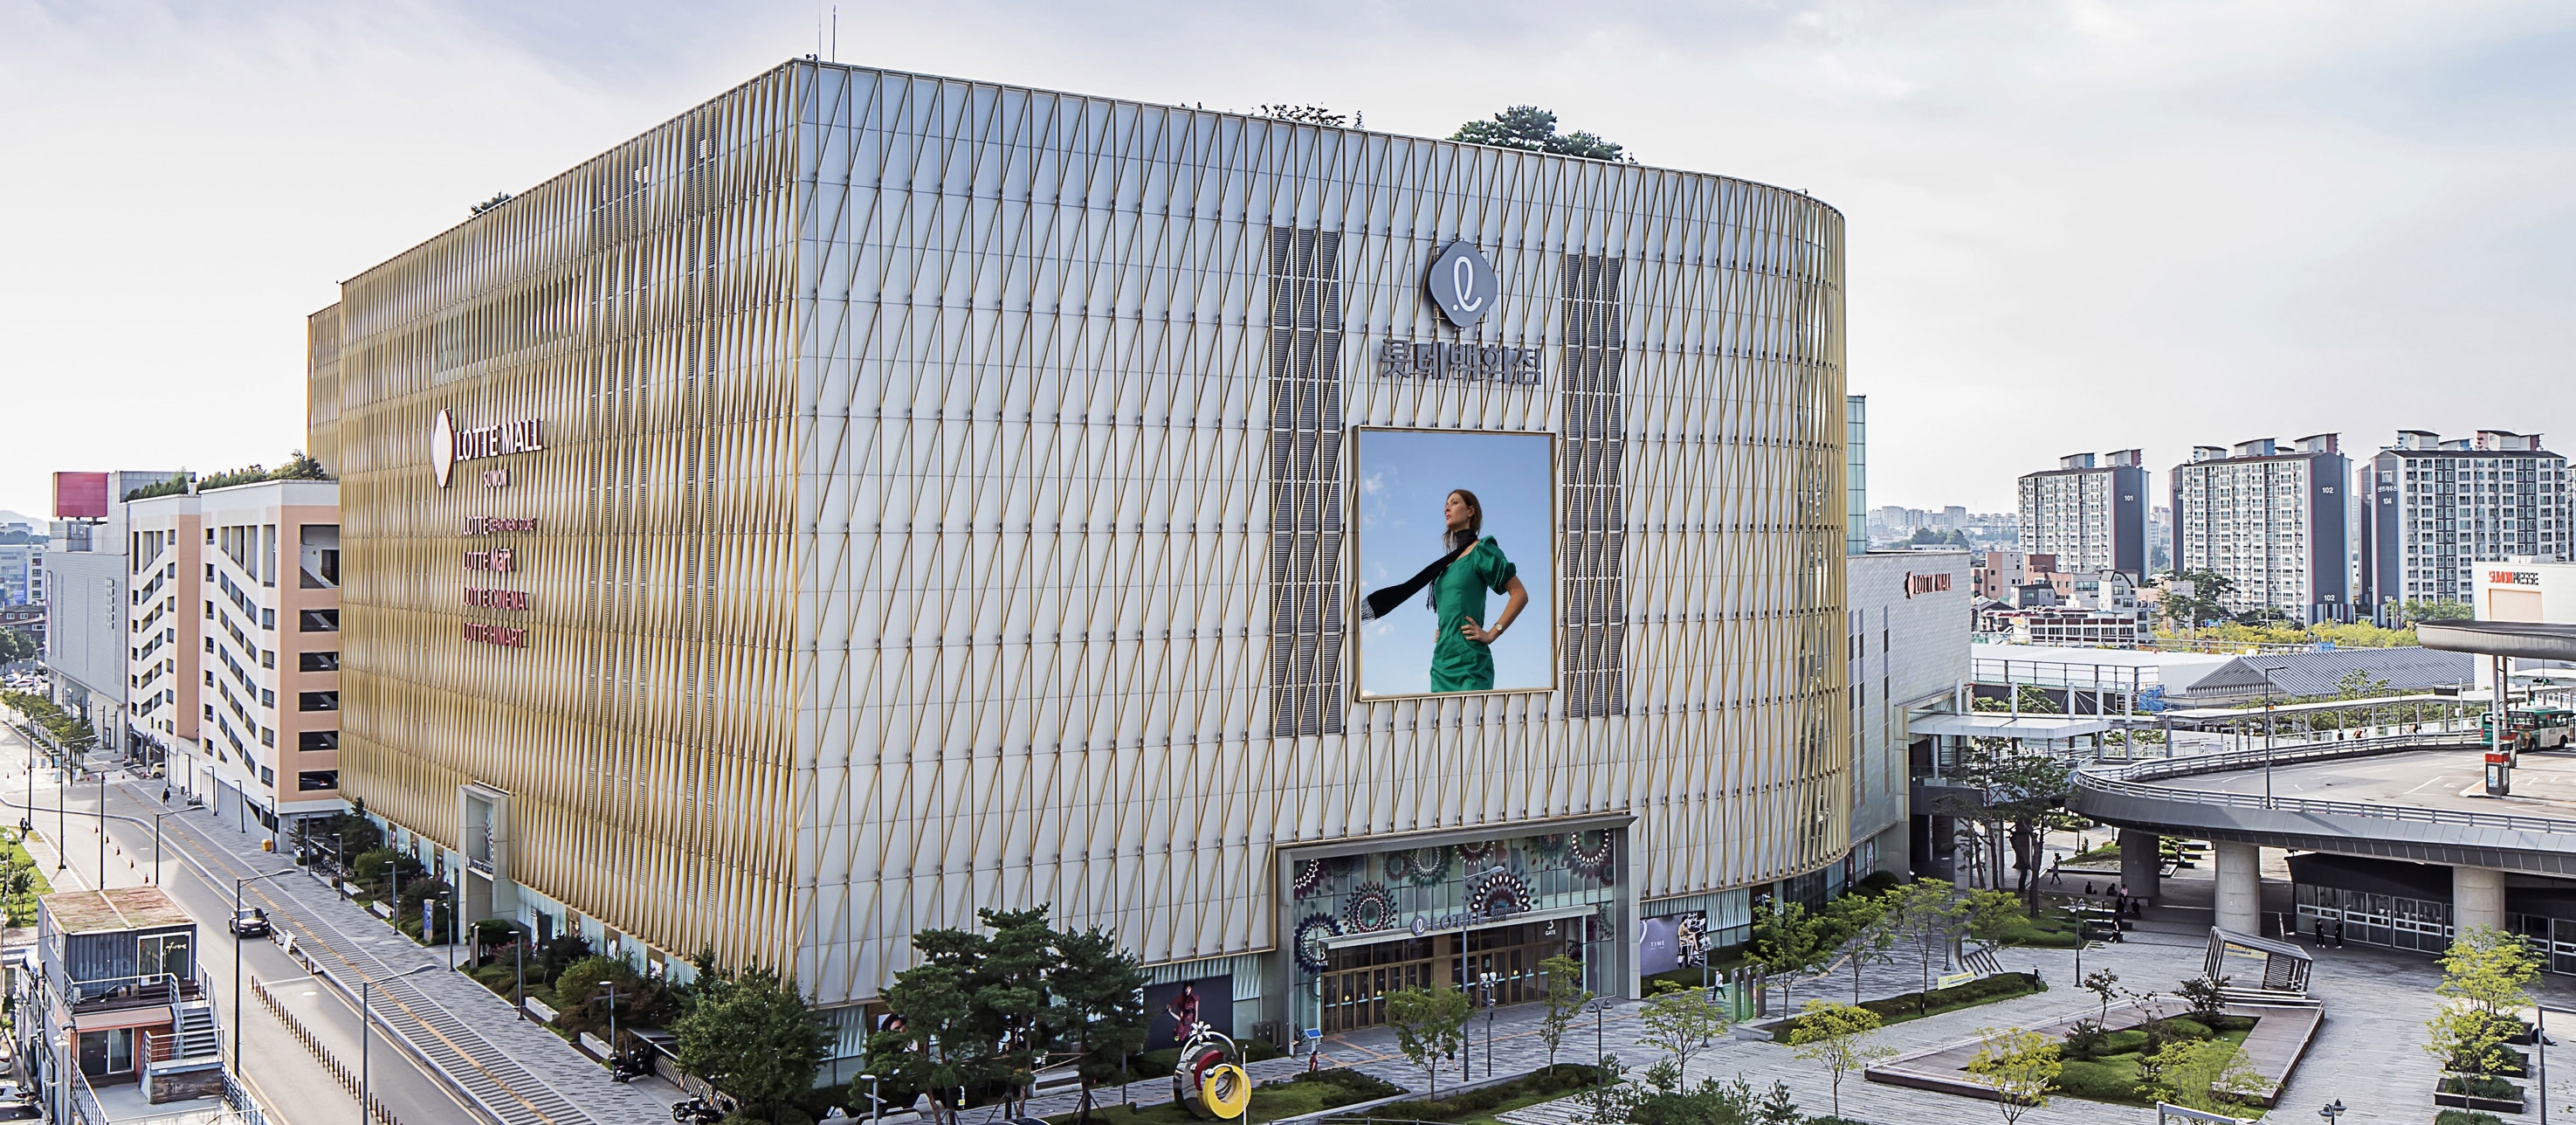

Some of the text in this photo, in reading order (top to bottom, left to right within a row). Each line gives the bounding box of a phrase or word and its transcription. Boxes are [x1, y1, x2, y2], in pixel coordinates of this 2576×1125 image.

[1381, 339, 1542, 385] 롯데백화점
[457, 418, 544, 461] LOTTE MALL
[483, 469, 507, 488] SUWON
[463, 516, 489, 535] LOTTE
[464, 549, 513, 571] LOTTE Mart
[463, 588, 527, 611] LOTTE CINEMA
[463, 623, 524, 649] LOTTE HIMART
[1431, 911, 1487, 931] LOTTE
[1547, 920, 1553, 929] 3
[1320, 947, 1326, 960] 3
